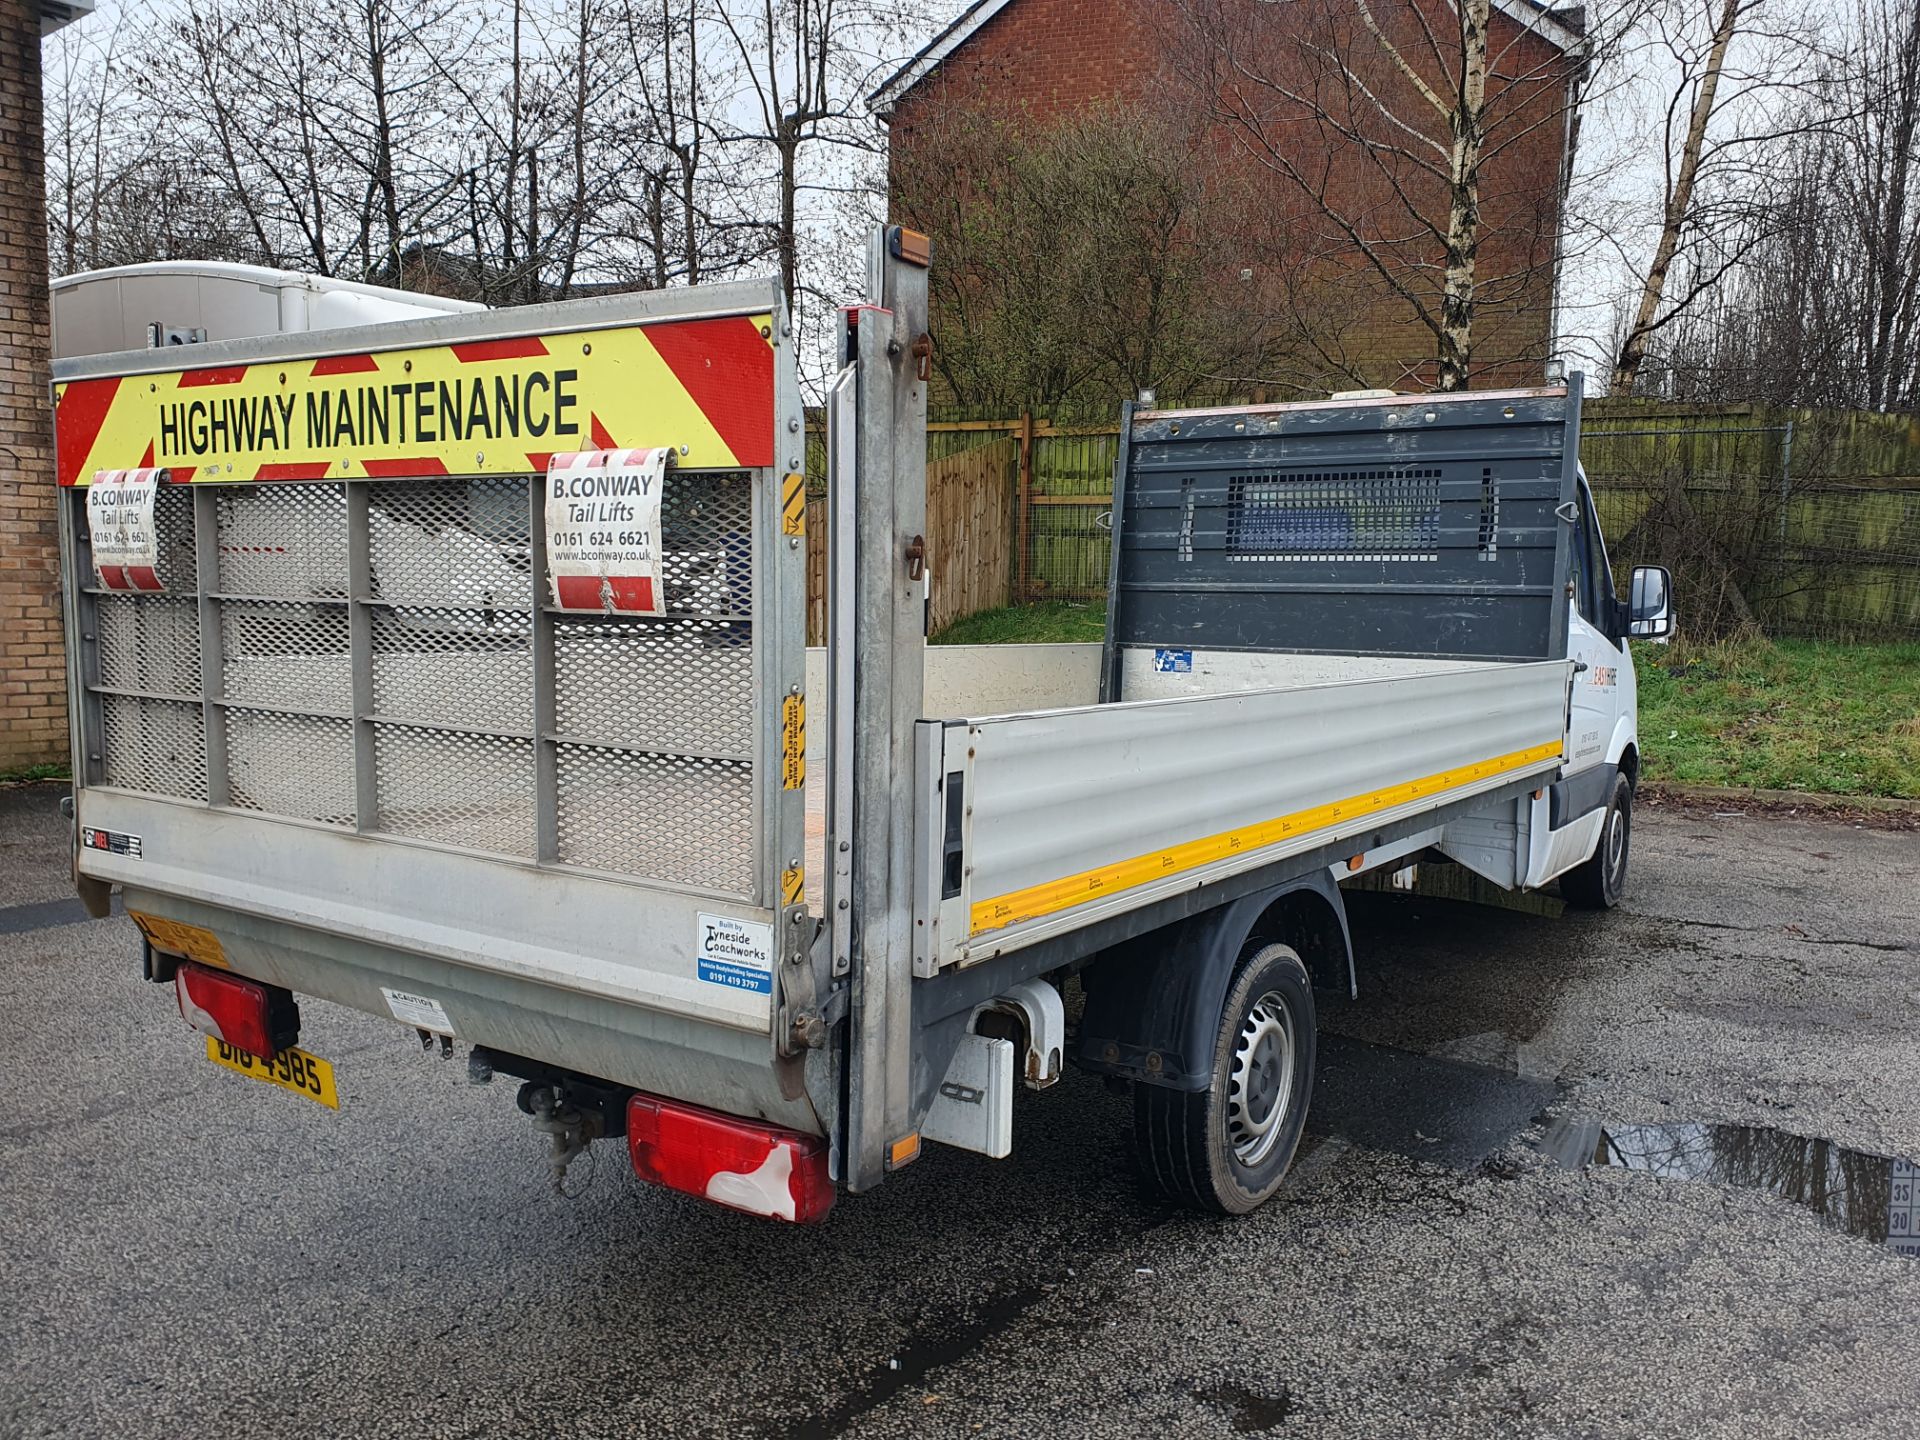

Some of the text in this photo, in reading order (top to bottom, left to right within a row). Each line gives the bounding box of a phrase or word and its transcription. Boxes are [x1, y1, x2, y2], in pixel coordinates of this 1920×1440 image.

[160, 369, 579, 456] HIGHWAY MAINTENANCE
[553, 475, 653, 499] B.CONWAY
[91, 490, 150, 506] B.CONWAY
[101, 510, 139, 525] Tail Lifts
[568, 501, 635, 523] Tail Lifts
[94, 532, 112, 543] 0161
[554, 531, 650, 546] 0161 624 6621
[554, 548, 652, 563] www.bconway.co.uk
[719, 920, 743, 932] Built by
[705, 925, 751, 945] Tyneside
[704, 936, 766, 960] Coachworks
[709, 972, 759, 989] 0191 419 3797
